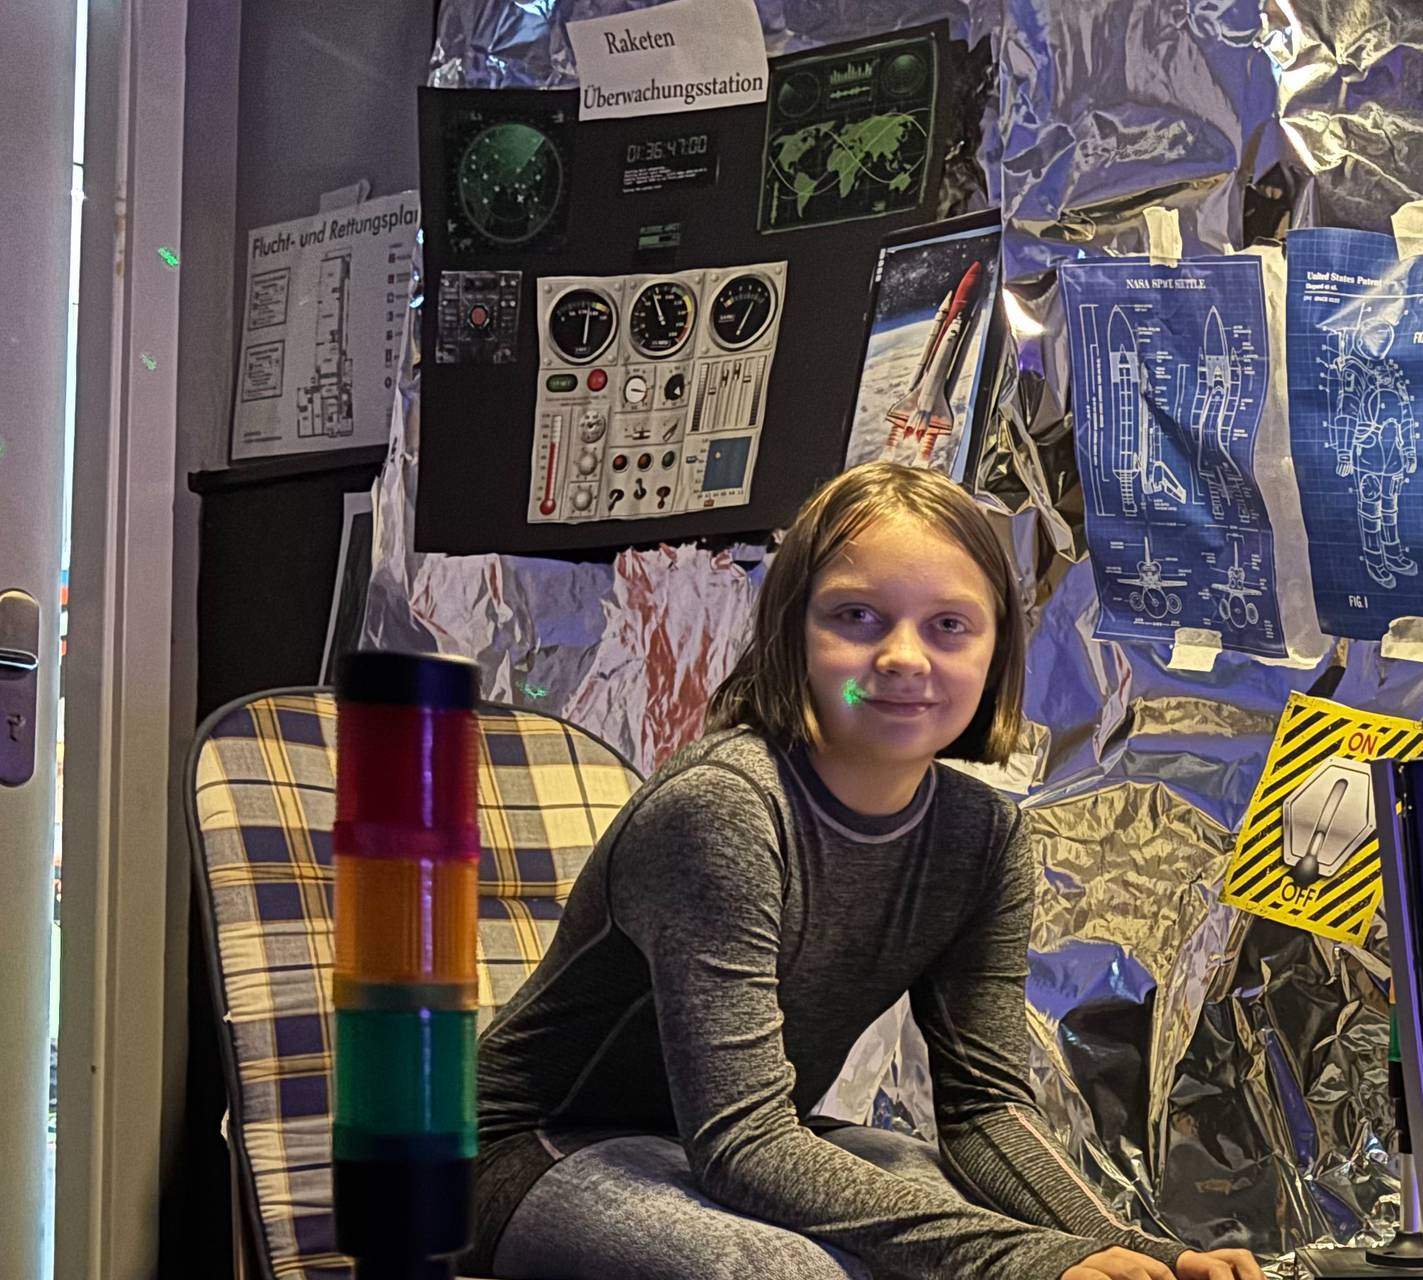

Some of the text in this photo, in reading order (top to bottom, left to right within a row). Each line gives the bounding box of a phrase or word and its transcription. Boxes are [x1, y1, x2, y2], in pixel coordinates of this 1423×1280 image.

[604, 29, 675, 54] Raketen
[584, 72, 763, 109] Überwachungsstation
[252, 232, 295, 259] Flucht-
[300, 222, 327, 247] und
[1126, 279, 1150, 289] NASA
[1307, 271, 1330, 281] United
[1331, 272, 1355, 283] States
[1348, 732, 1378, 755] ON
[1282, 882, 1316, 907] OFF
